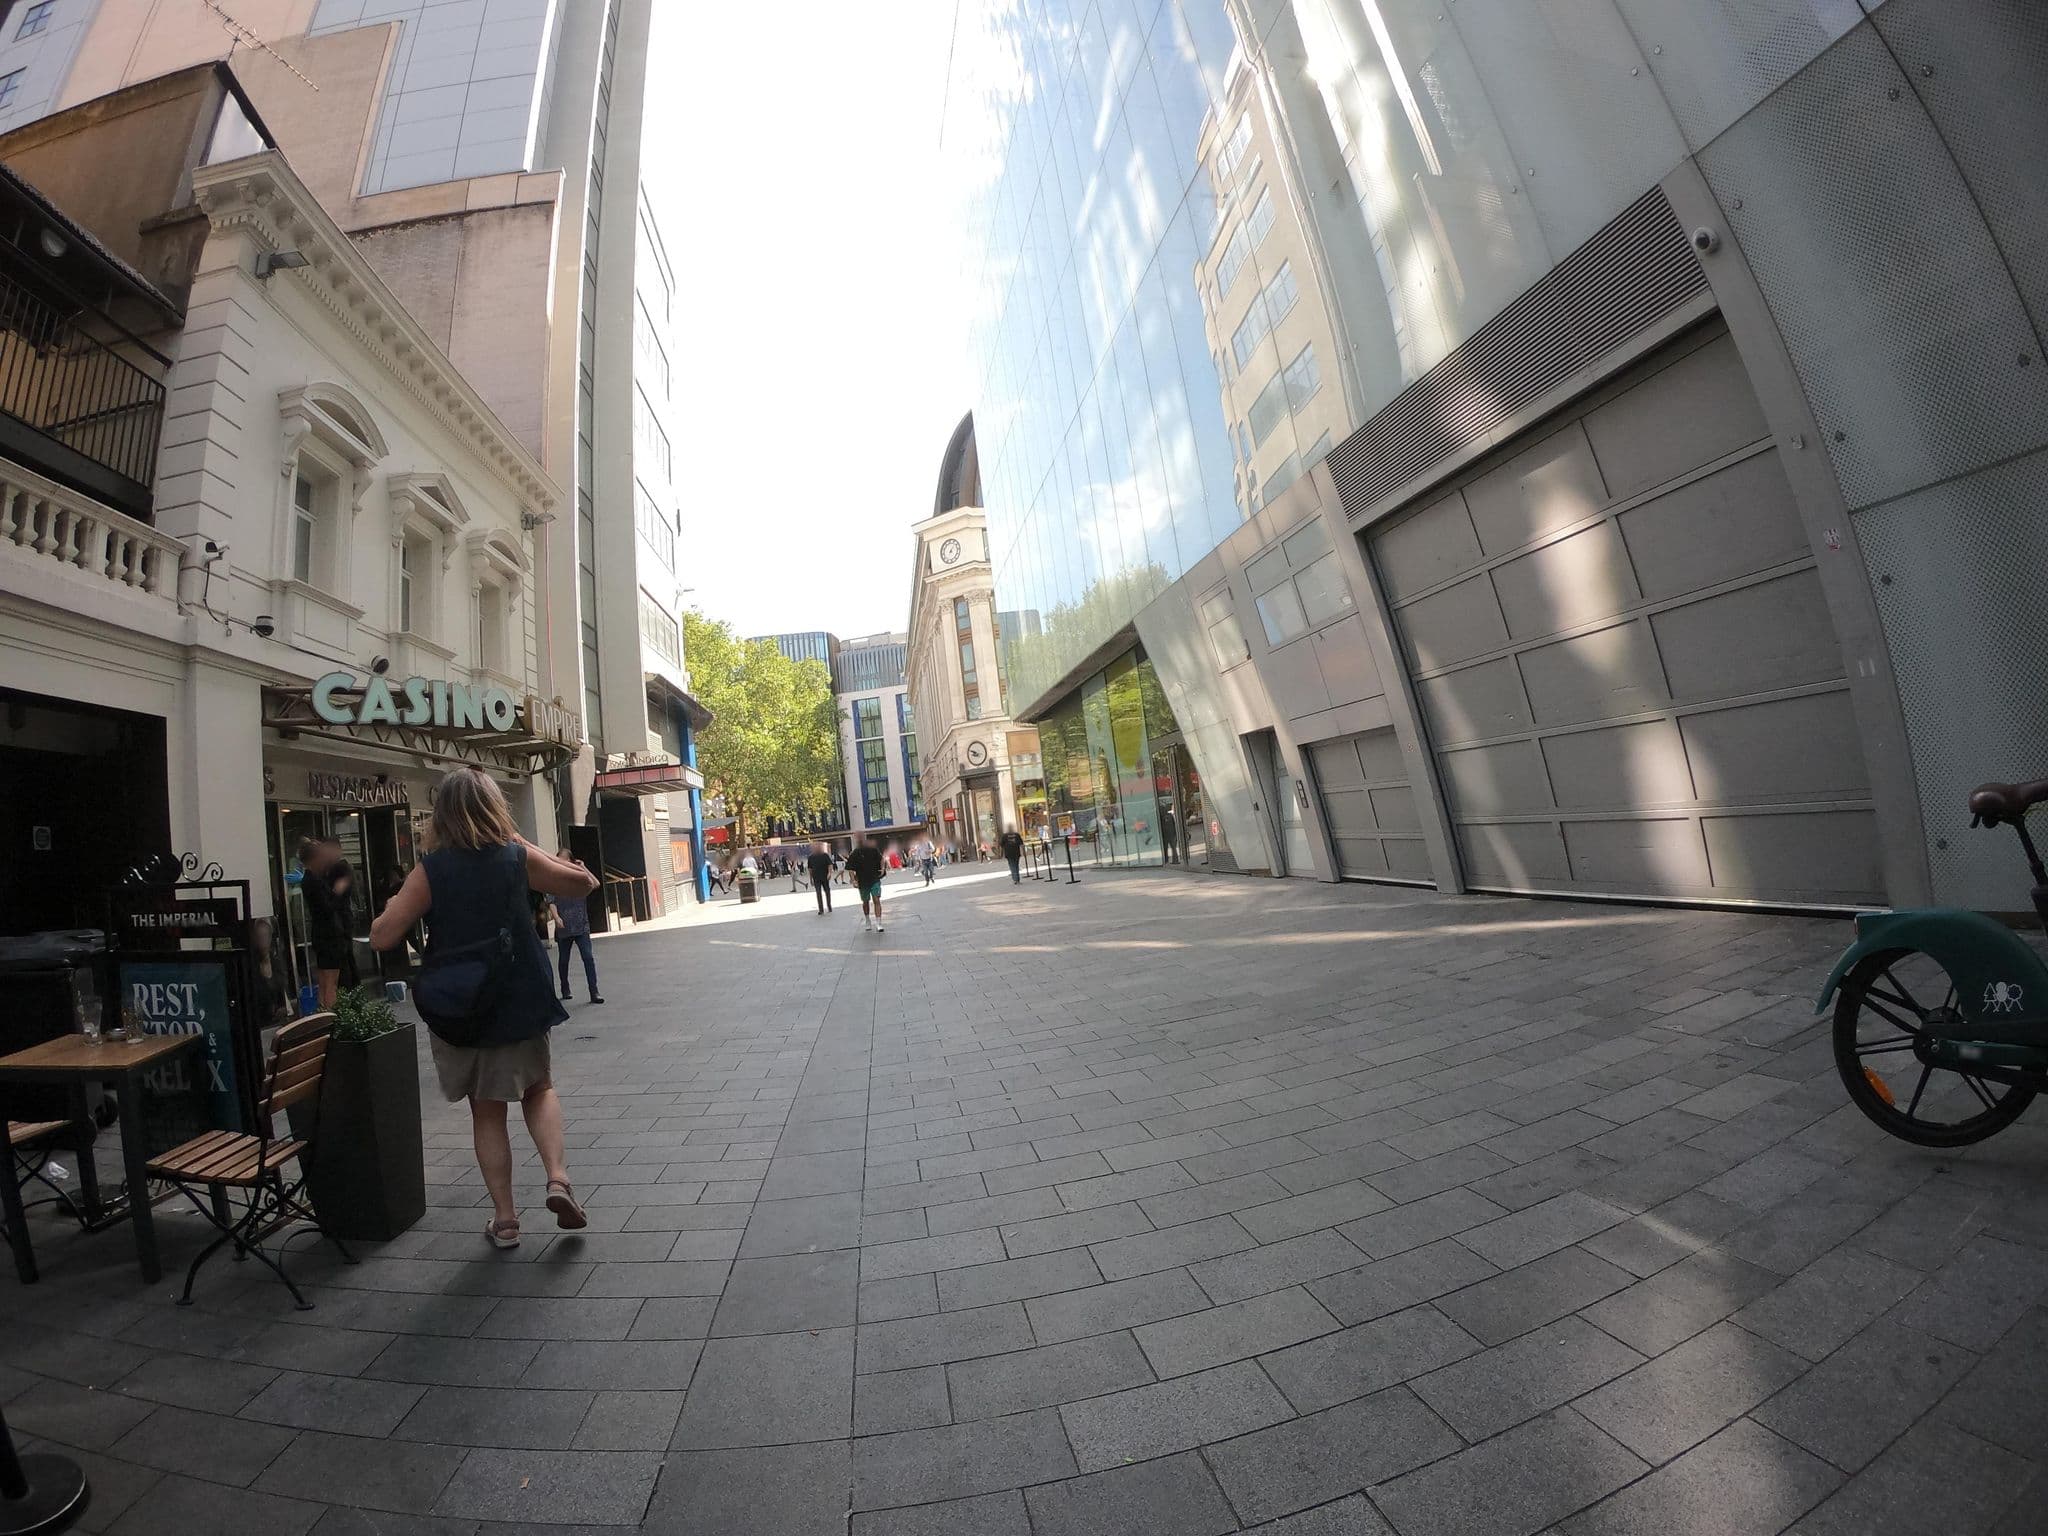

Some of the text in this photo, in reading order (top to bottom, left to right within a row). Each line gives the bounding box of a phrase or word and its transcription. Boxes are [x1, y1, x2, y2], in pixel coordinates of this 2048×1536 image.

[312, 673, 515, 731] CASINO
[531, 699, 580, 742] EMPIRE
[308, 770, 408, 804] RESTAURANTS
[131, 912, 219, 928] THE IMPERIAL
[132, 983, 206, 1020] REST,
